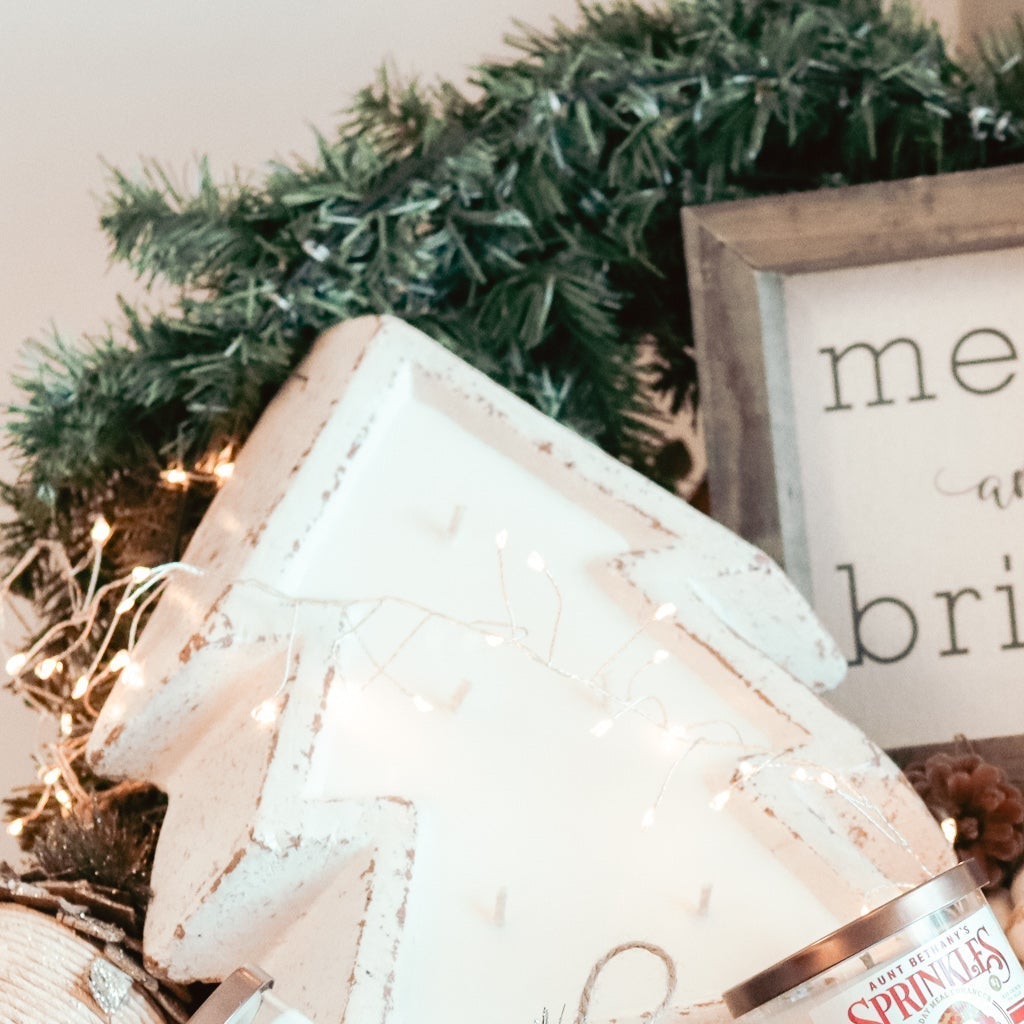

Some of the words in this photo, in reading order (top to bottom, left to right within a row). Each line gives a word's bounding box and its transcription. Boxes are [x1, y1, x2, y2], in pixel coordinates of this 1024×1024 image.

[868, 965, 904, 992] AUNT
[908, 925, 971, 968] BETHANY'S
[929, 990, 950, 1009] MEAL
